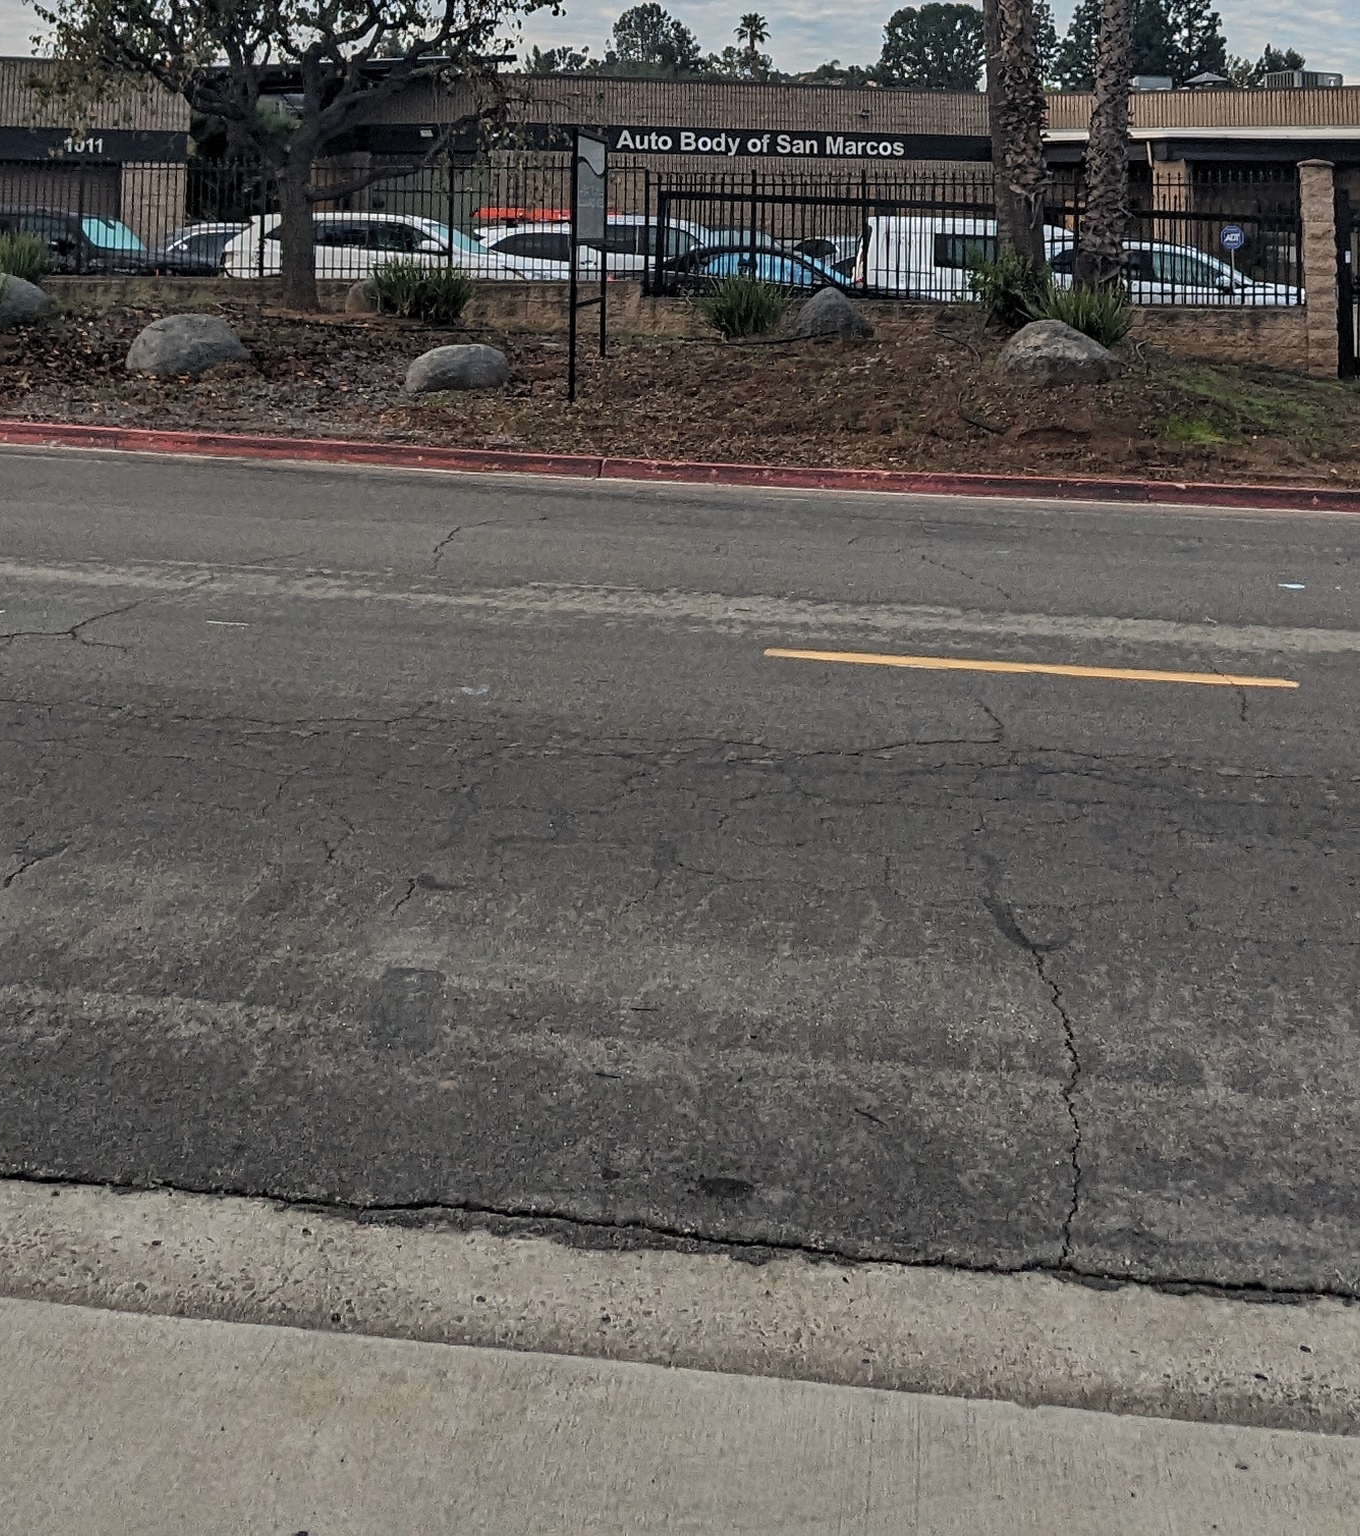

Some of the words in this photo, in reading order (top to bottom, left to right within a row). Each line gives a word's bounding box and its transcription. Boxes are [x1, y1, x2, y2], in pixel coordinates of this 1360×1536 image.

[63, 137, 104, 154] 1011
[616, 129, 673, 151] Auto
[680, 131, 740, 156] Body
[747, 134, 771, 153] of
[776, 134, 818, 155] San
[825, 136, 905, 156] Marcos
